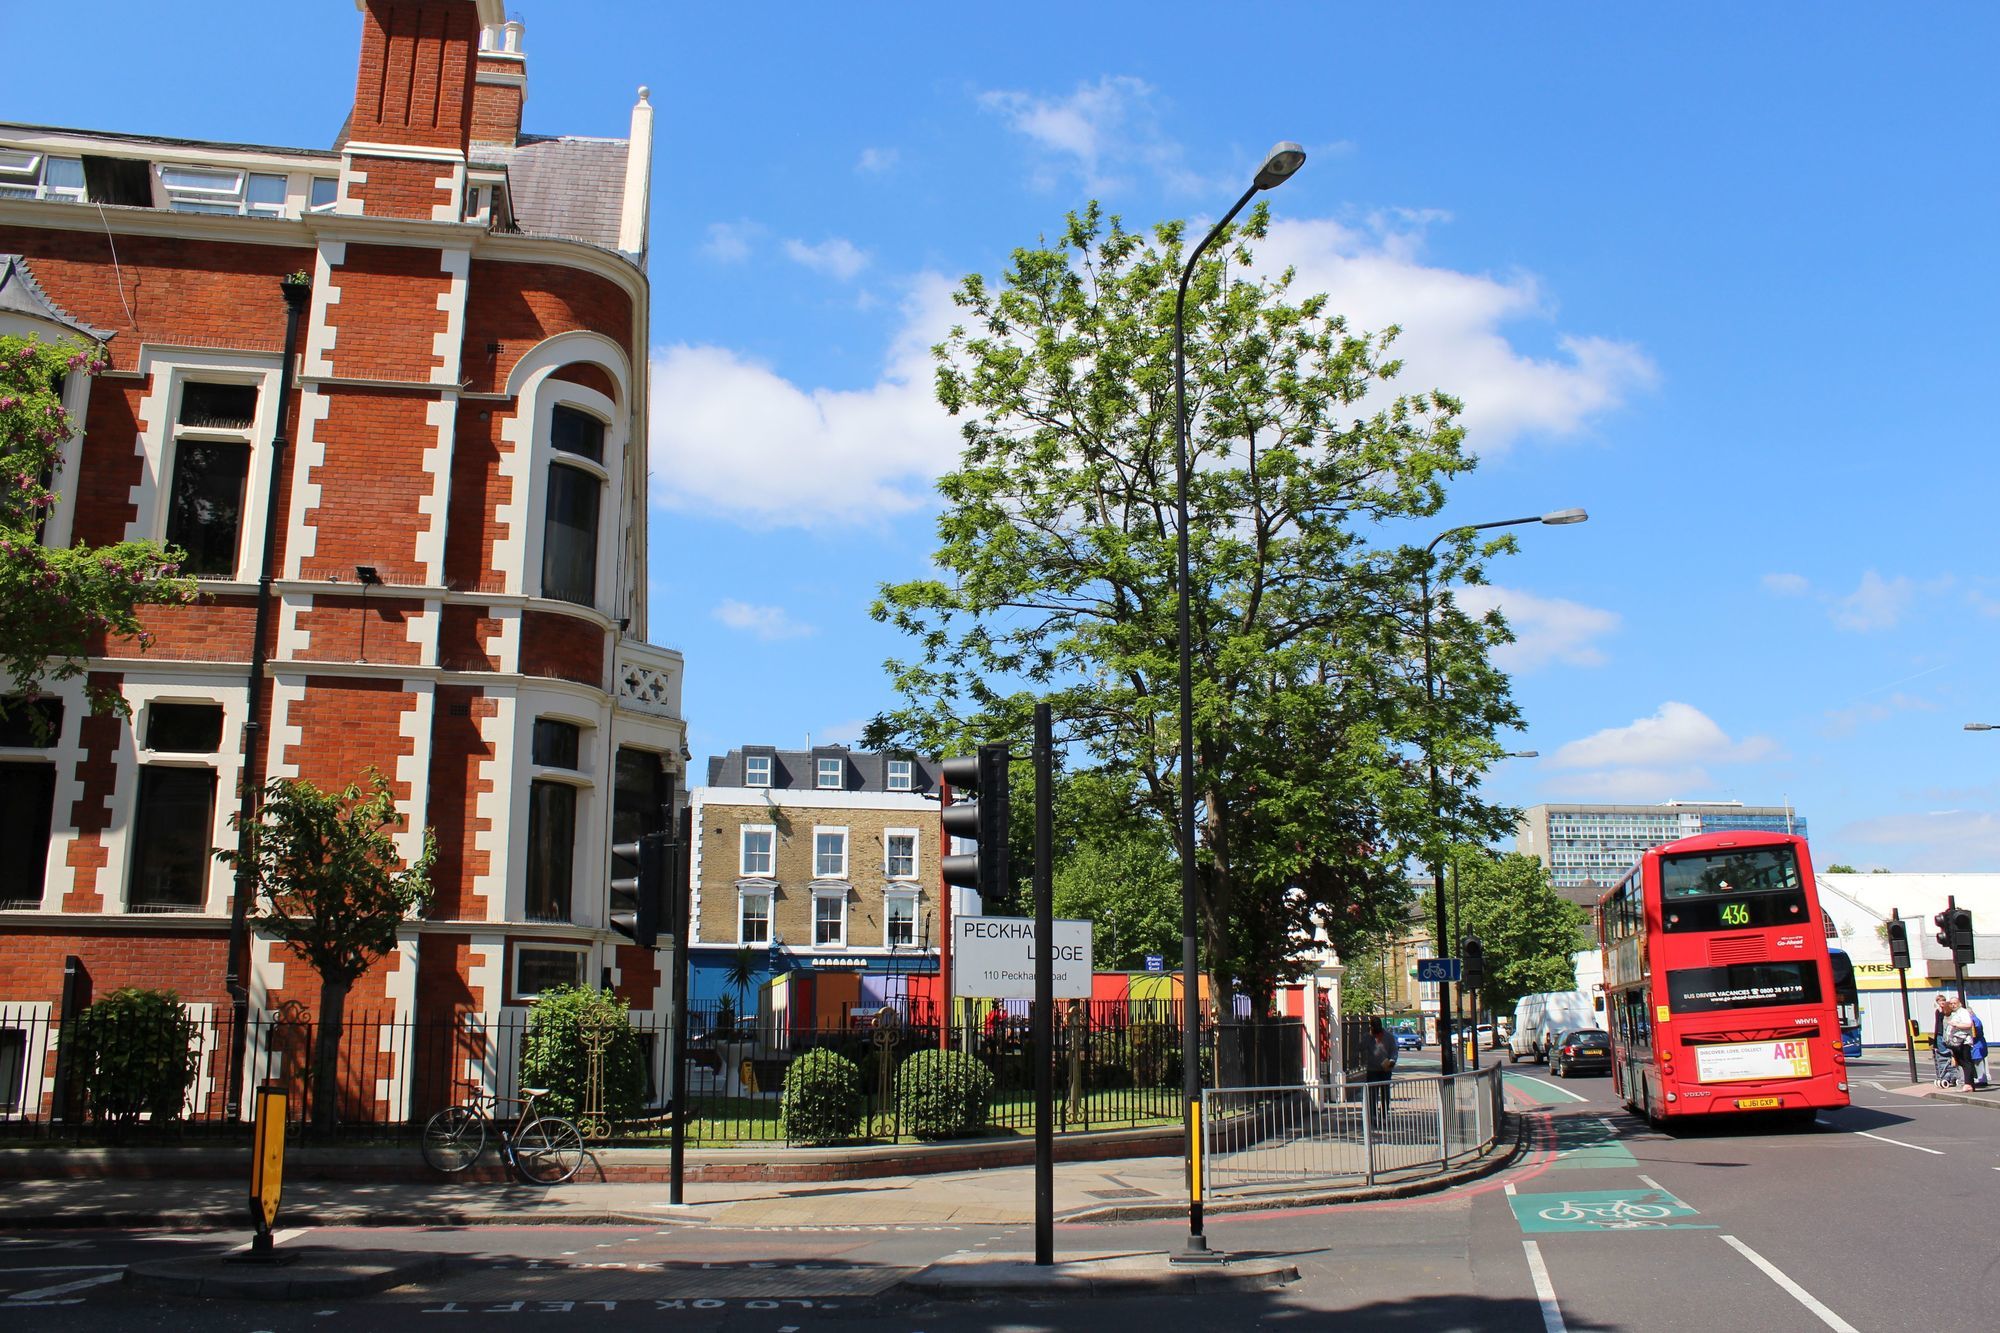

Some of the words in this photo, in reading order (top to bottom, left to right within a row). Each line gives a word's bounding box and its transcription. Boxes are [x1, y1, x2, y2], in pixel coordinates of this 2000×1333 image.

[1722, 904, 1749, 925] 436
[964, 922, 1036, 939] PECKHA
[1027, 945, 1083, 961] LDGE
[983, 970, 999, 980] 110
[1051, 971, 1067, 981] oad
[1695, 991, 1717, 999] DRIVER
[1717, 989, 1750, 997] VACANCIES
[1774, 1042, 1805, 1060] ART
[1791, 1059, 1809, 1076] 15
[421, 1300, 618, 1312] LEFT
[655, 1299, 814, 1311] LOOK
